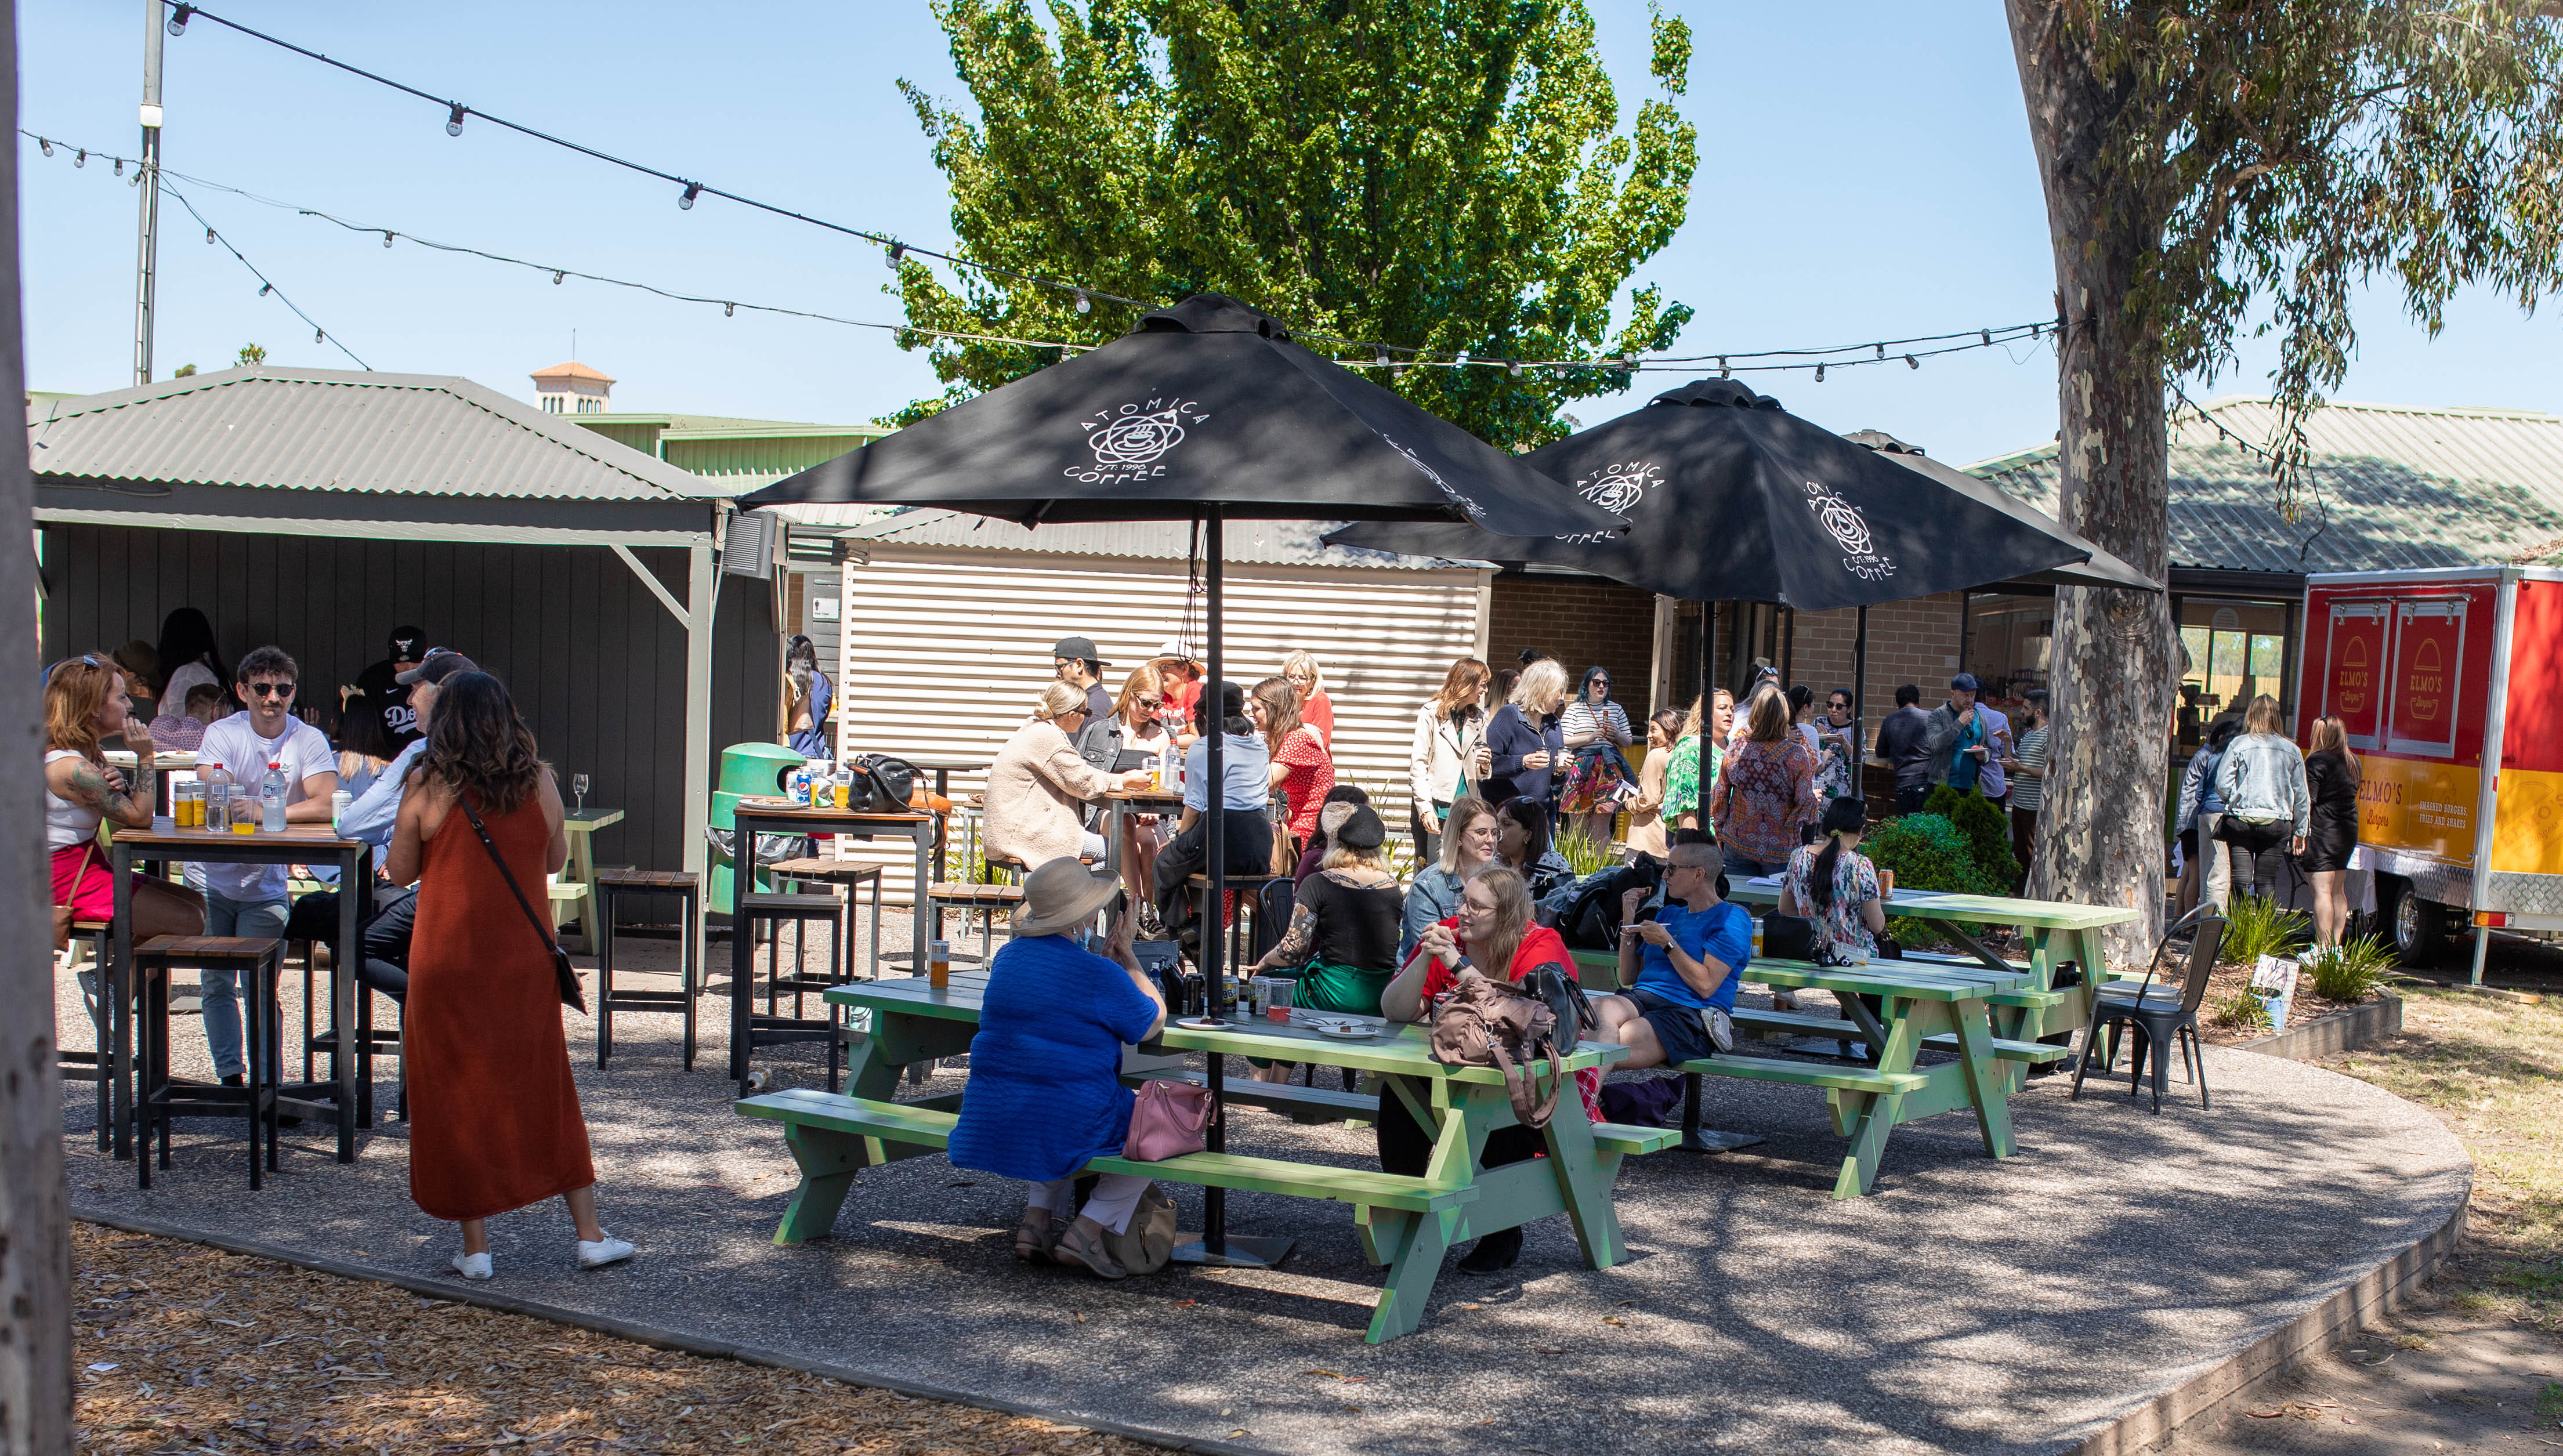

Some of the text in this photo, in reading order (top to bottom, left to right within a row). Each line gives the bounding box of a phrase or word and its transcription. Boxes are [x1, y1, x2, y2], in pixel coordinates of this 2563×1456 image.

[1080, 398, 1210, 432] ATOMICA
[1063, 465, 1166, 484] COFFEE
[1576, 461, 1665, 488] ATOMICA
[1802, 481, 1863, 513] AOMICA
[1843, 556, 1897, 581] COFFEE
[2339, 671, 2369, 687] ELMO'S
[2410, 675, 2442, 693] ELMO'S
[2359, 780, 2402, 805] ELMO'S
[2419, 801, 2442, 812] SMASHED
[2366, 809, 2389, 830] Burgers
[2419, 813, 2466, 829] FRIES AND SHAKES
